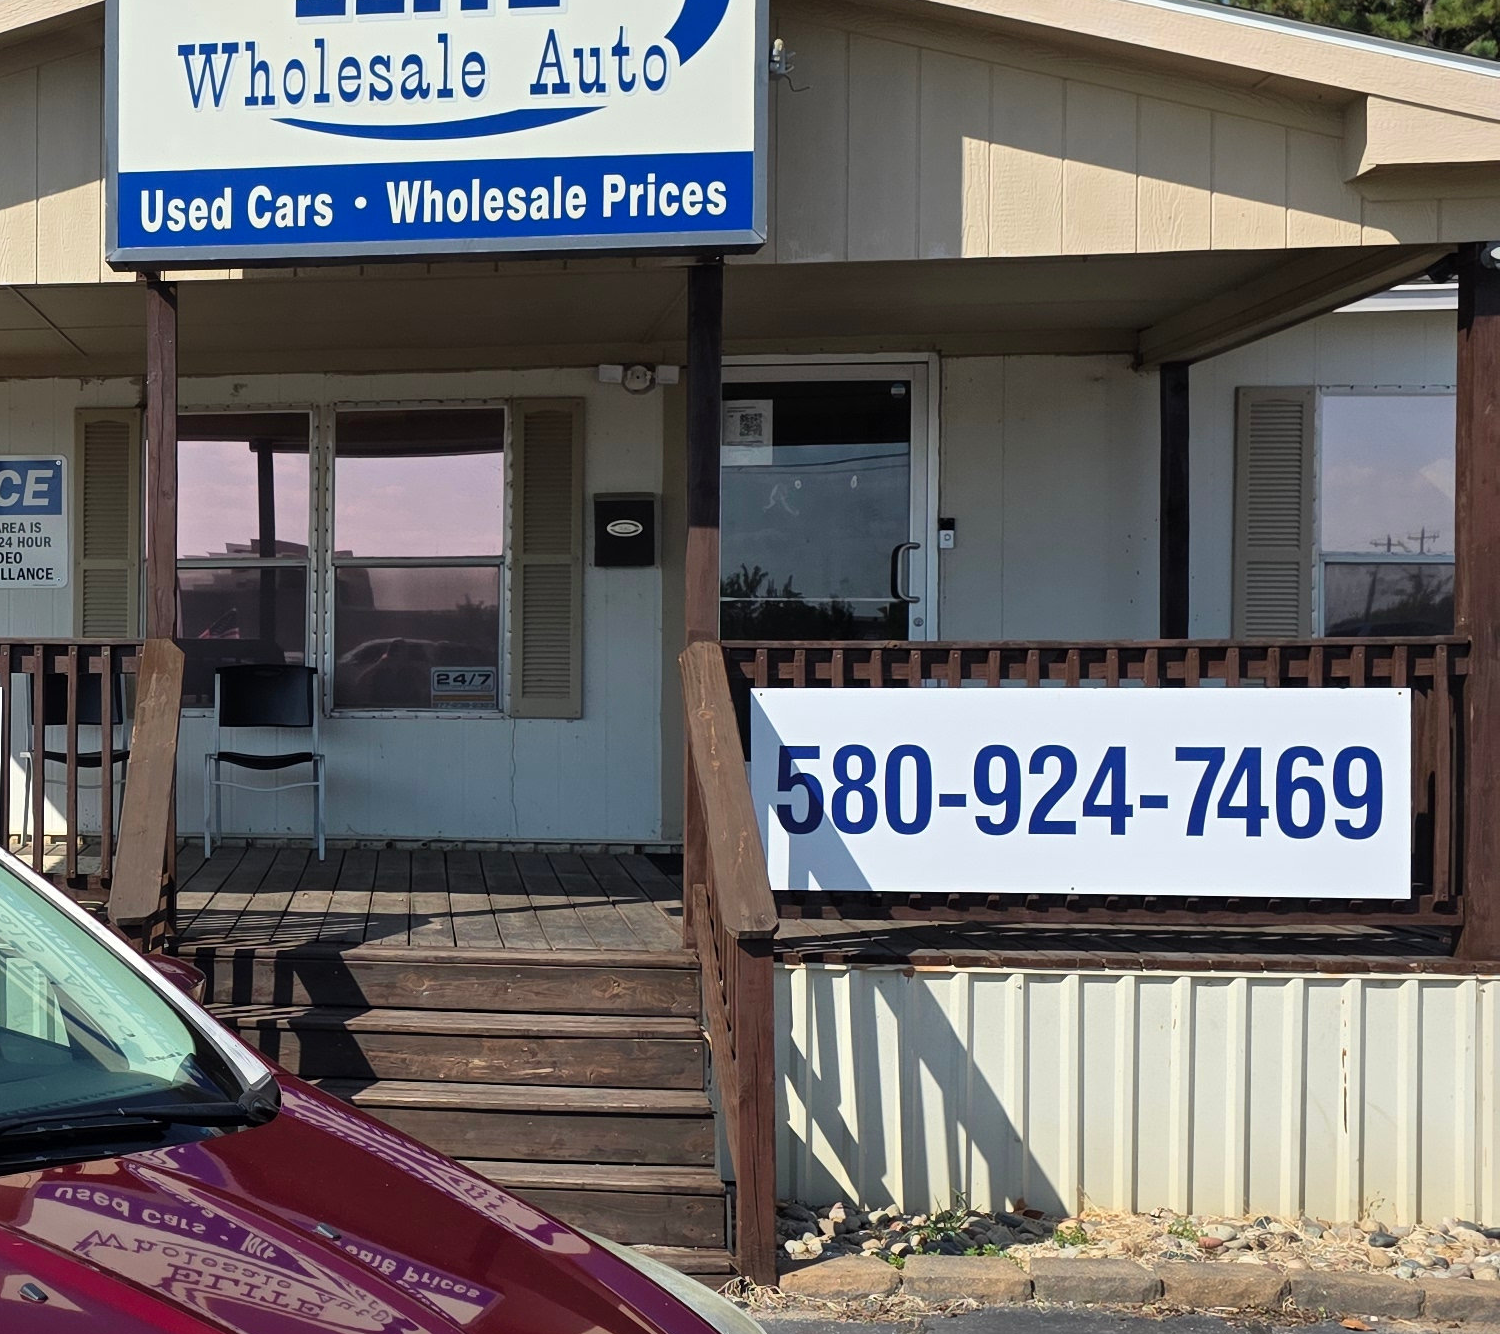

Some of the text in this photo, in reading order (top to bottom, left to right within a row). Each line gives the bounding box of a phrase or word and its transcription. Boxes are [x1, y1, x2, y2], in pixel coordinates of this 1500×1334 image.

[177, 25, 669, 109] Wholesale Auto
[139, 173, 728, 234] Used Cars Wholesale Prices
[17, 536, 52, 548] HOUR
[30, 521, 42, 533] IS
[436, 673, 492, 685] 24/7
[775, 743, 1384, 840] 580-924-7469
